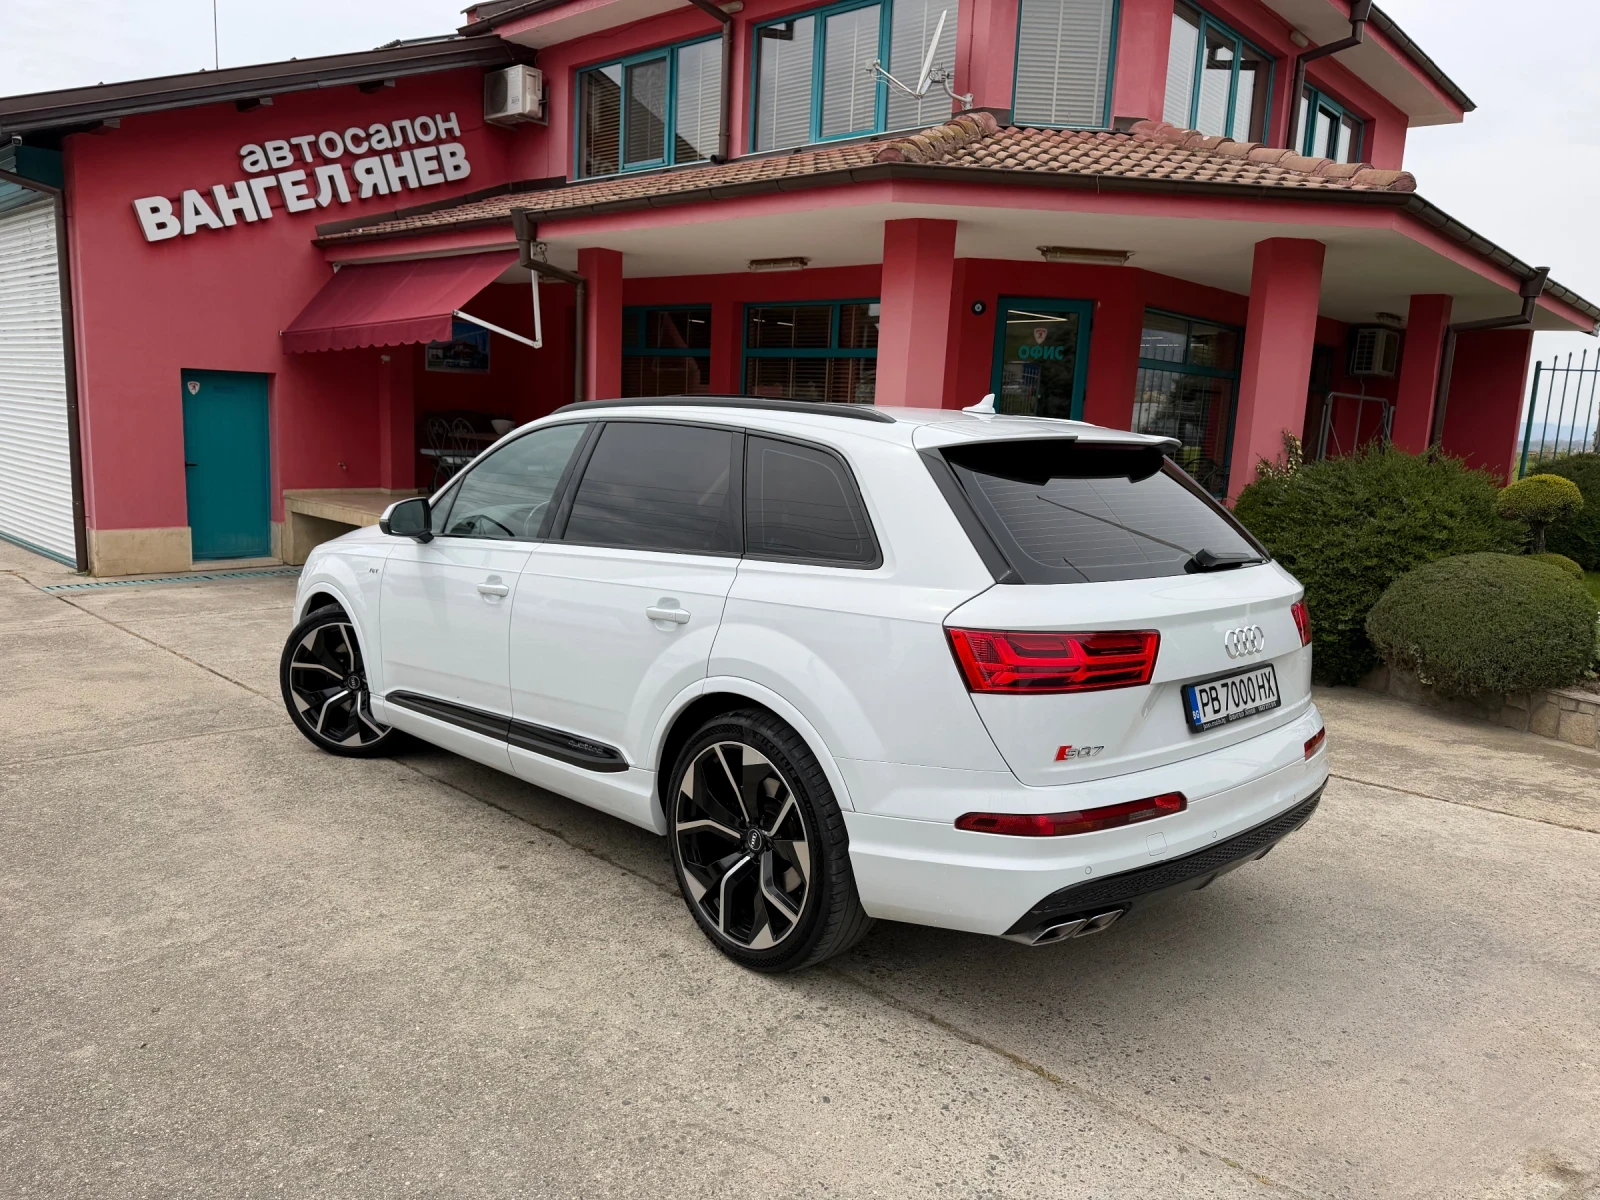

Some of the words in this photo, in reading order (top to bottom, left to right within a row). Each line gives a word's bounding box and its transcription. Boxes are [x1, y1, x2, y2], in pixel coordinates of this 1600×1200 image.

[239, 112, 461, 173] автосалон
[133, 163, 352, 242] ВАНГЕЛ
[352, 142, 471, 199] ЯНЕВ
[1018, 345, 1064, 360] ОФИС
[1221, 676, 1256, 712] 7000
[1193, 710, 1200, 720] BG
[1065, 745, 1105, 760] SQ7
